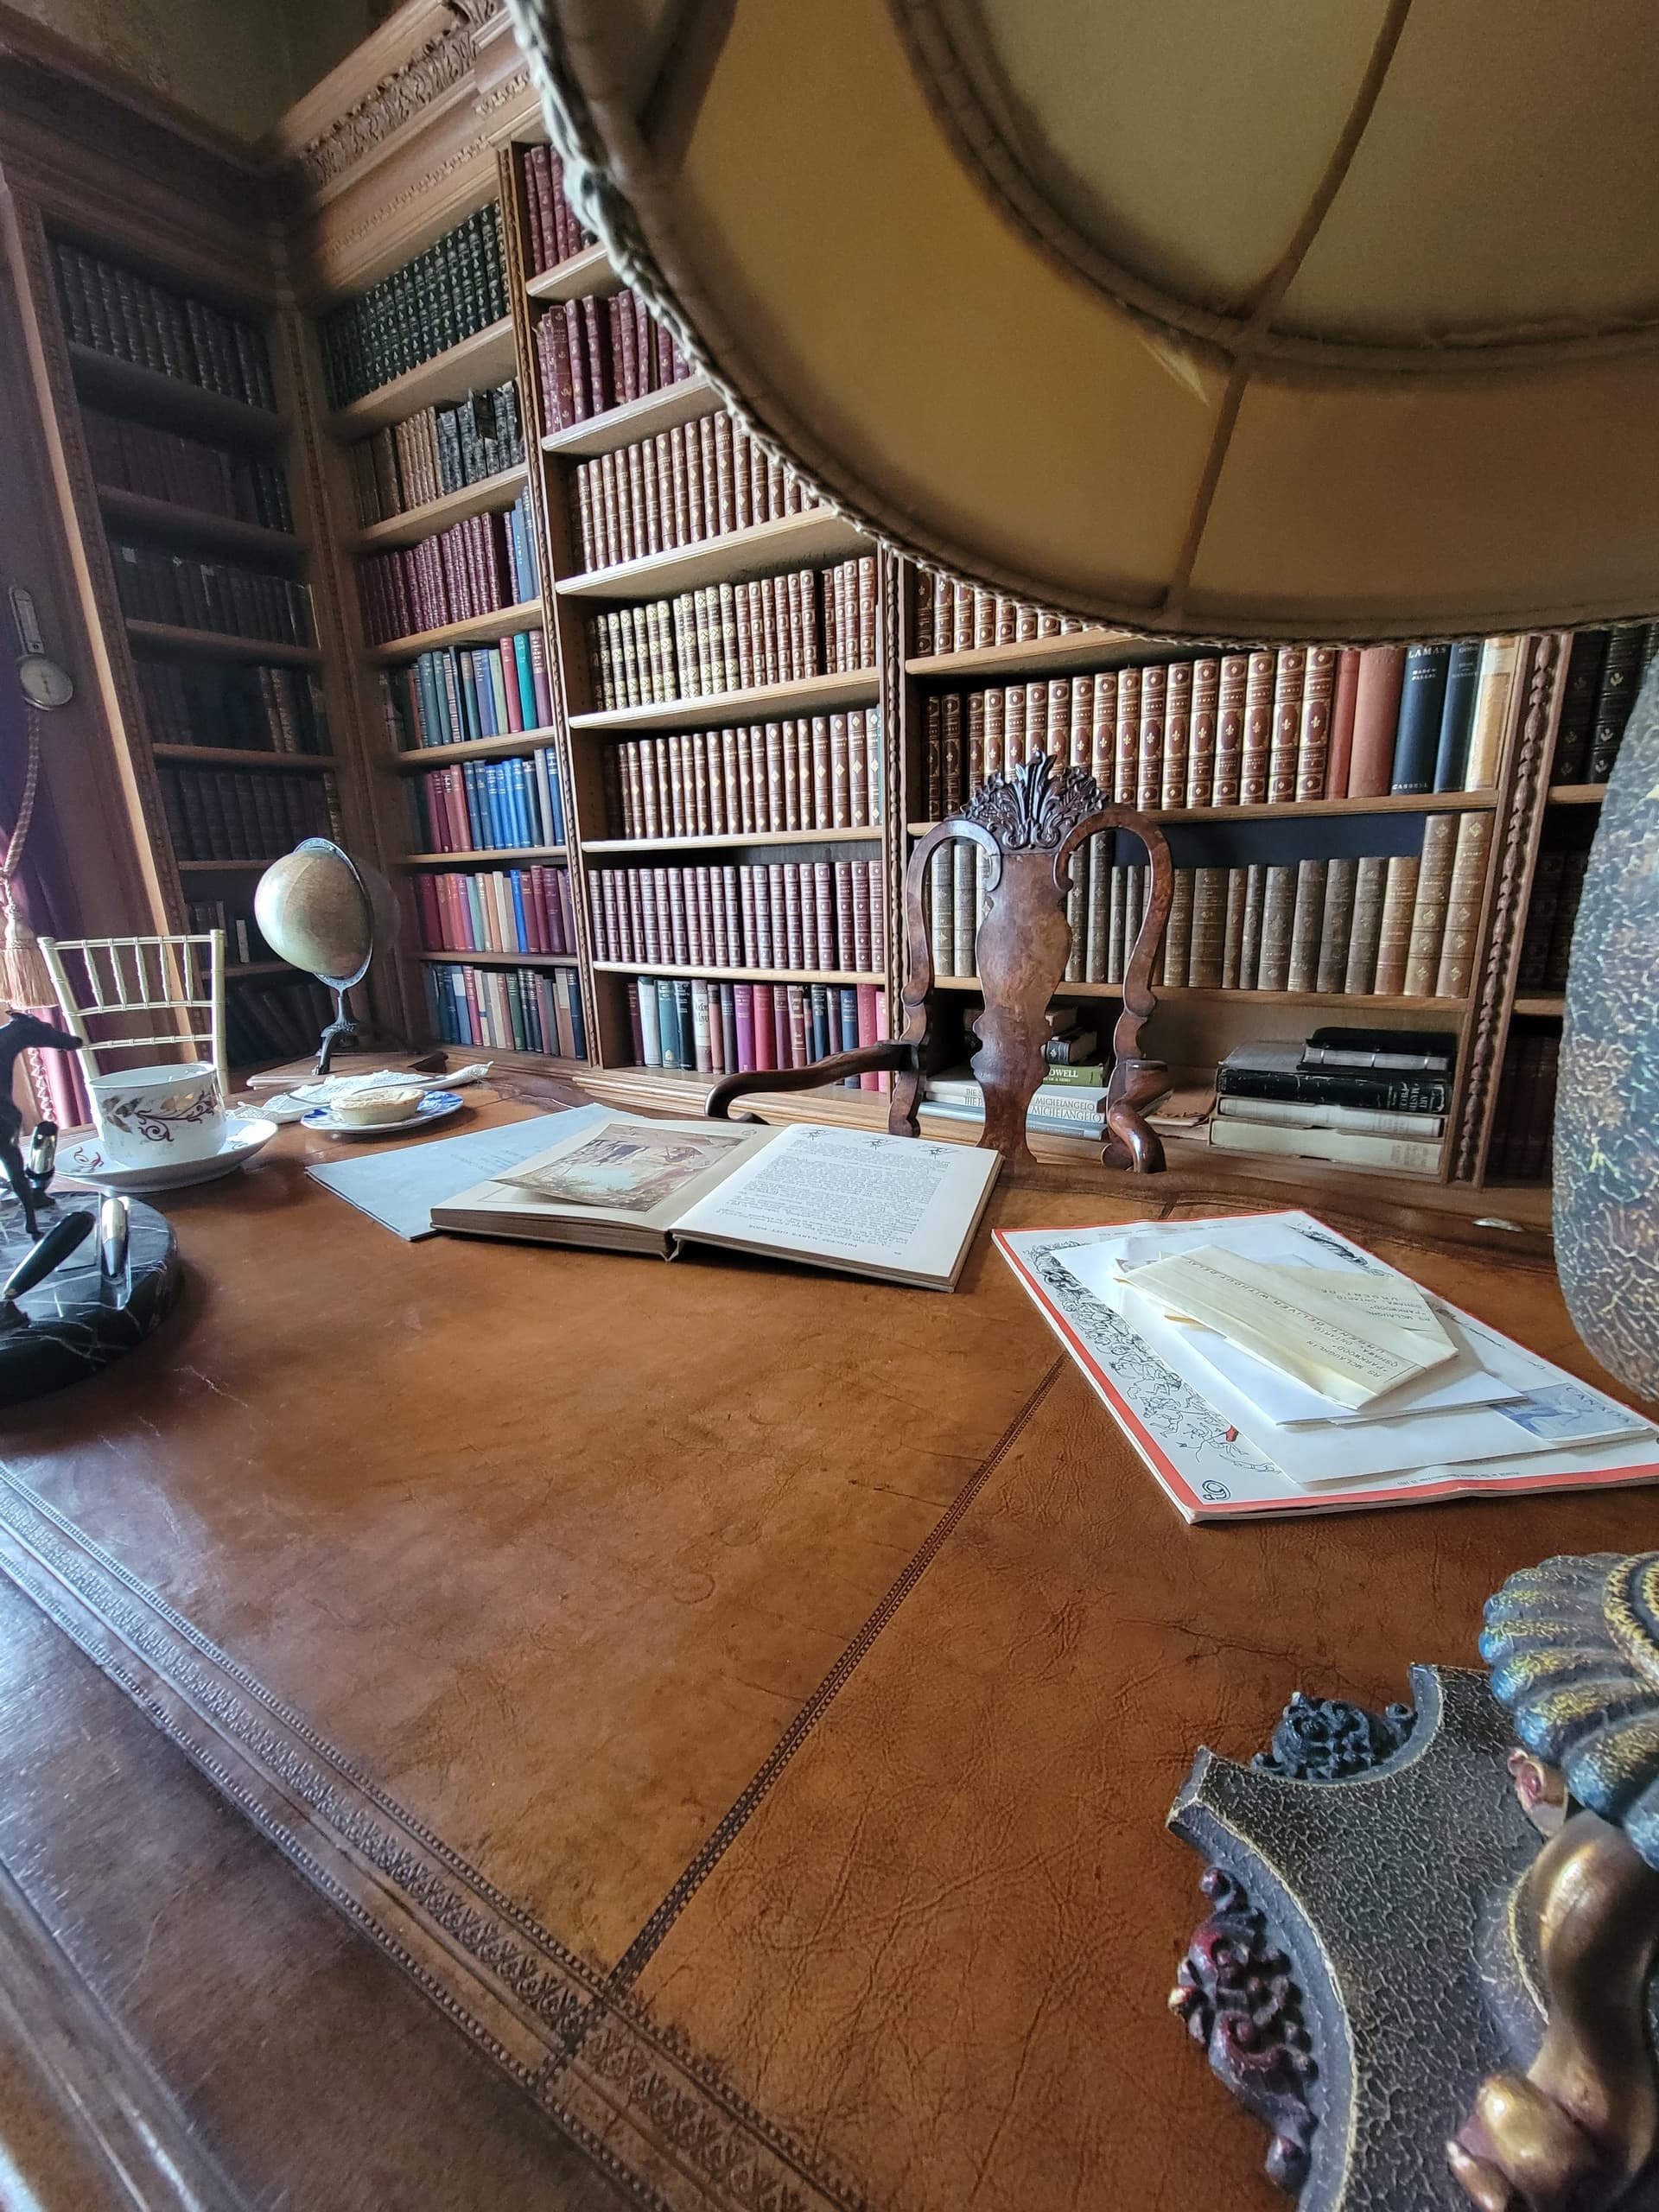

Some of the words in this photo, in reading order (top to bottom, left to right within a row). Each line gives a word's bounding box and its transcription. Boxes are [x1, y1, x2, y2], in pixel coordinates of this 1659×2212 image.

[1408, 646, 1446, 659] LAMAS
[1048, 1068, 1078, 1078] OWELL
[963, 1096, 976, 1106] THE
[1032, 1105, 1102, 1122] MICHELANGELO
[965, 1088, 977, 1097] THE
[1036, 1096, 1095, 1111] MICHELANGELO
[1186, 1258, 1218, 1274] DELAY
[1220, 1274, 1269, 1300] WITHOUT
[1273, 1300, 1325, 1326] DELIVER
[1313, 1326, 1353, 1345] ONTARIO
[1332, 1326, 1385, 1353] URGENT
[1367, 1370, 1382, 1378] RS
